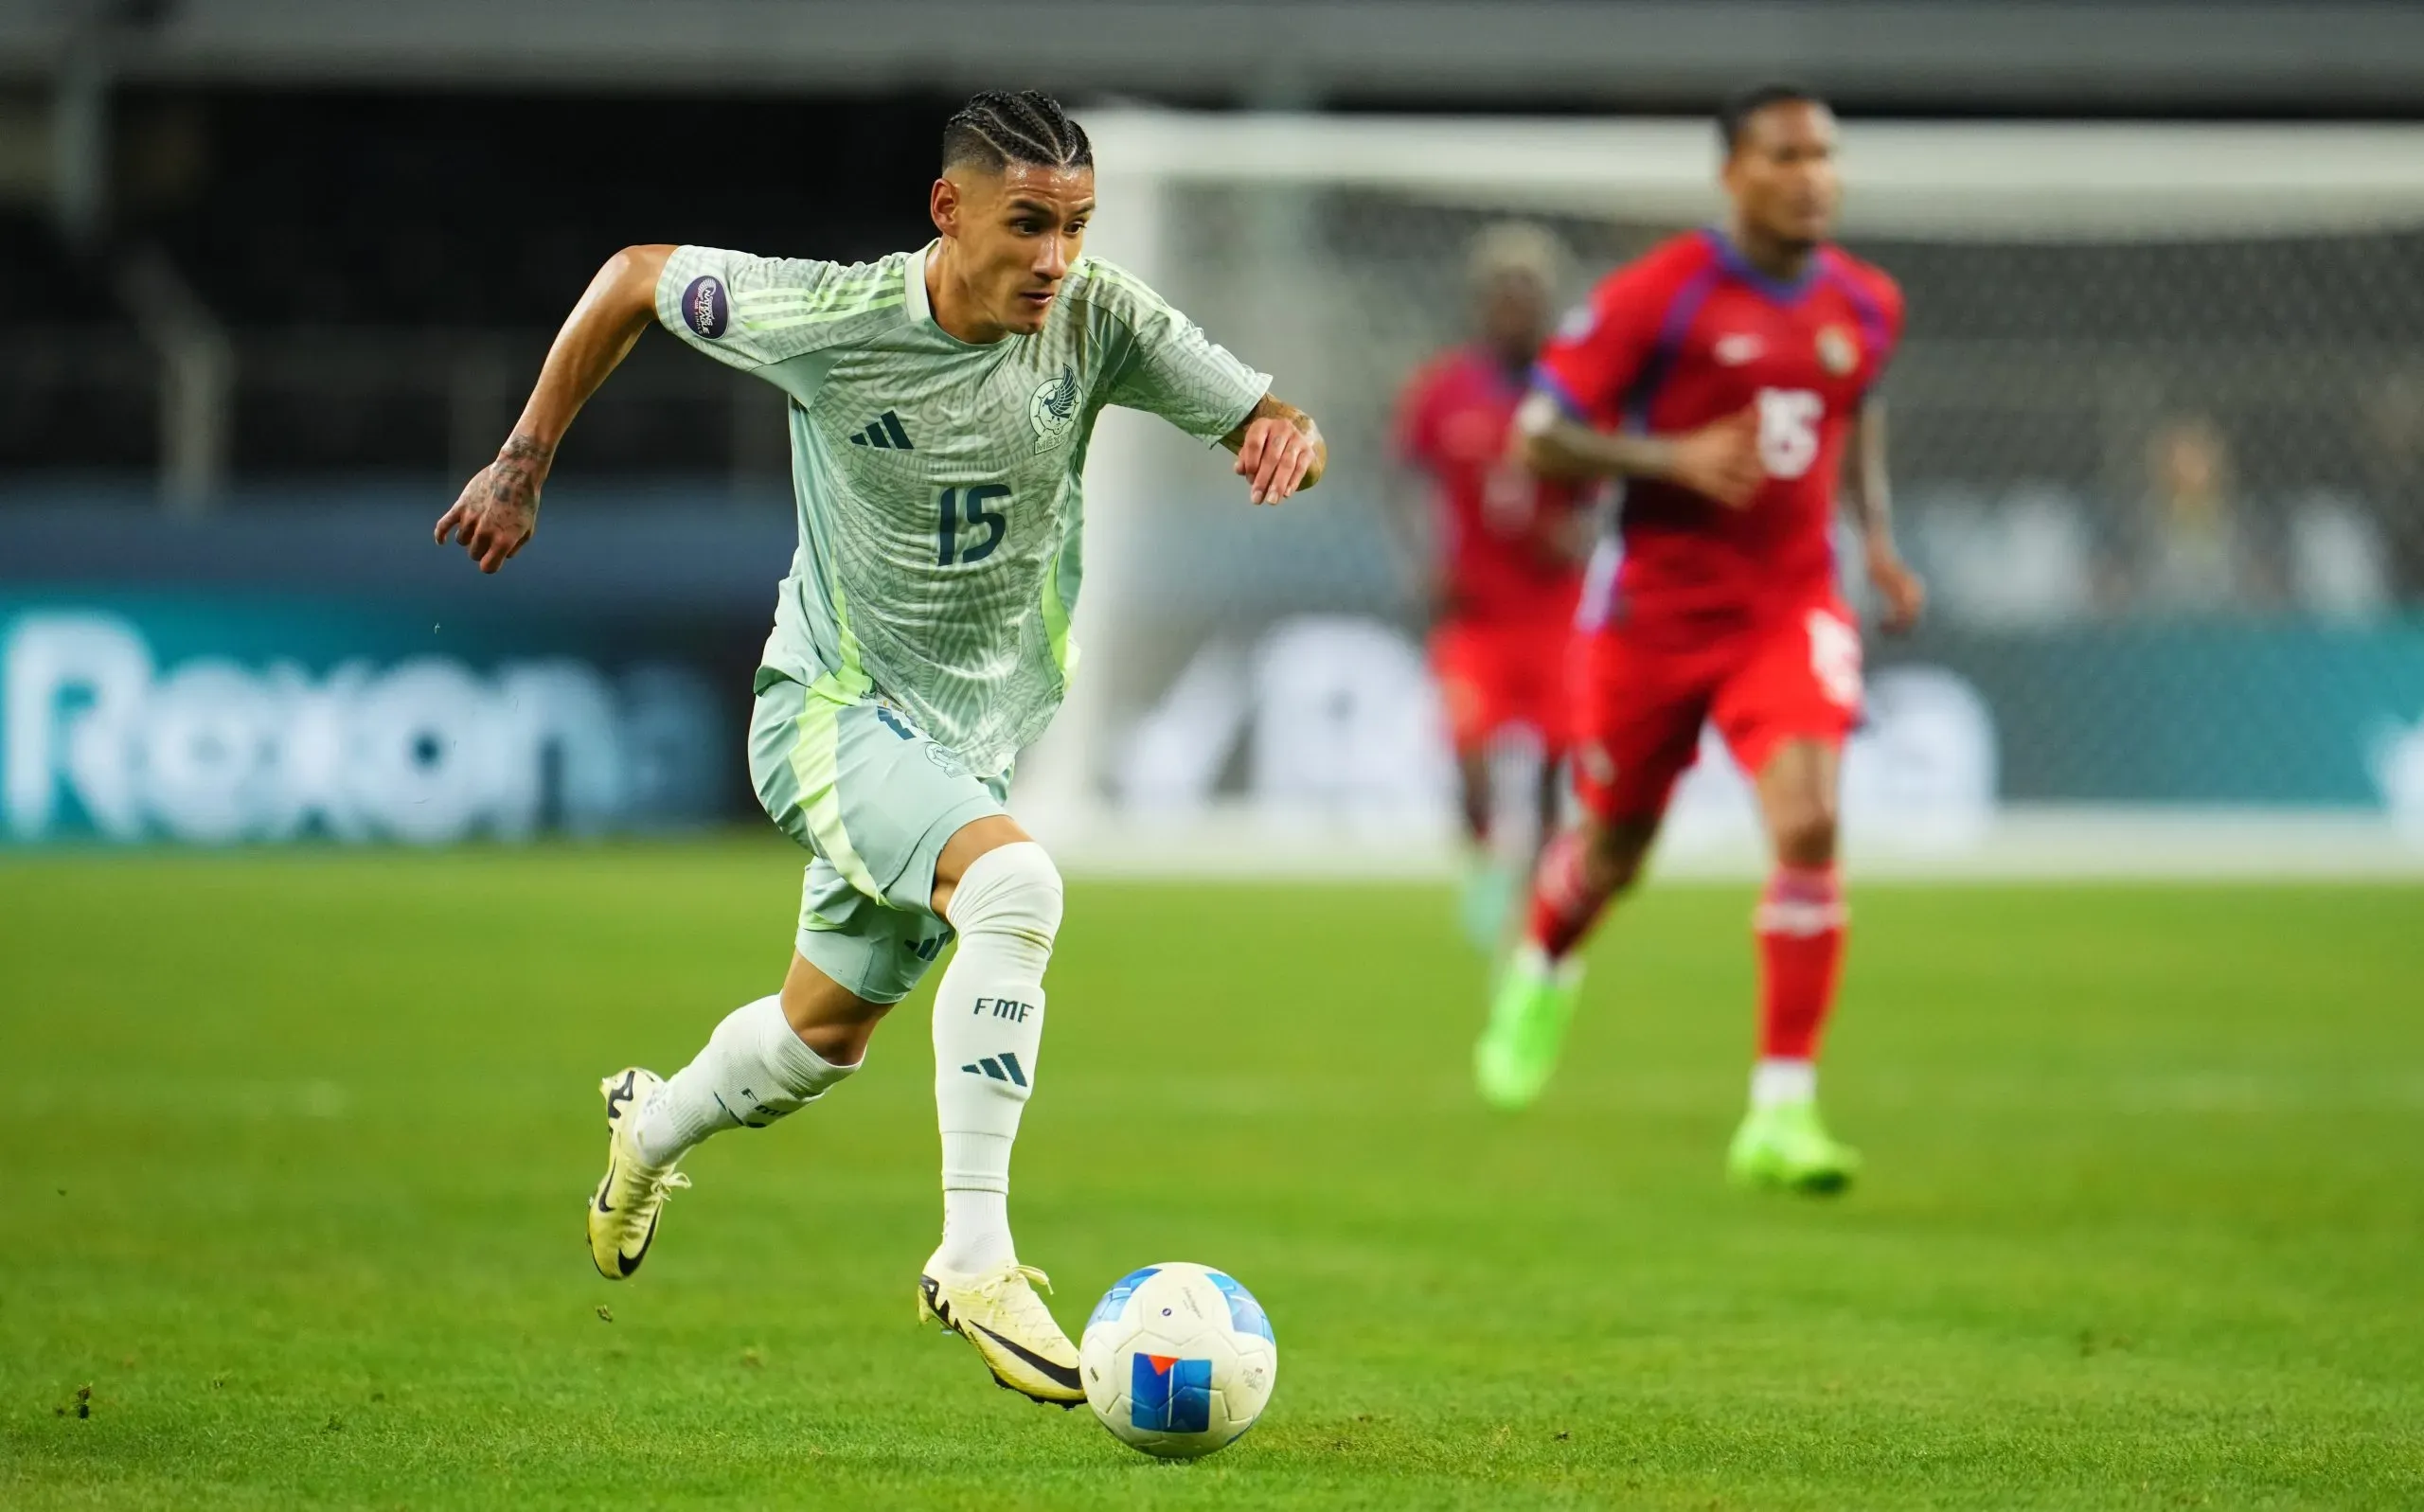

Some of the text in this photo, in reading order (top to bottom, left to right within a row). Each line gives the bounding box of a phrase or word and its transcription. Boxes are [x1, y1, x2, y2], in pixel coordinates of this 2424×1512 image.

[698, 301, 710, 335] LEAGUE
[704, 289, 714, 327] NATIONS
[937, 484, 1011, 567] 15
[973, 997, 1035, 1023] FMF
